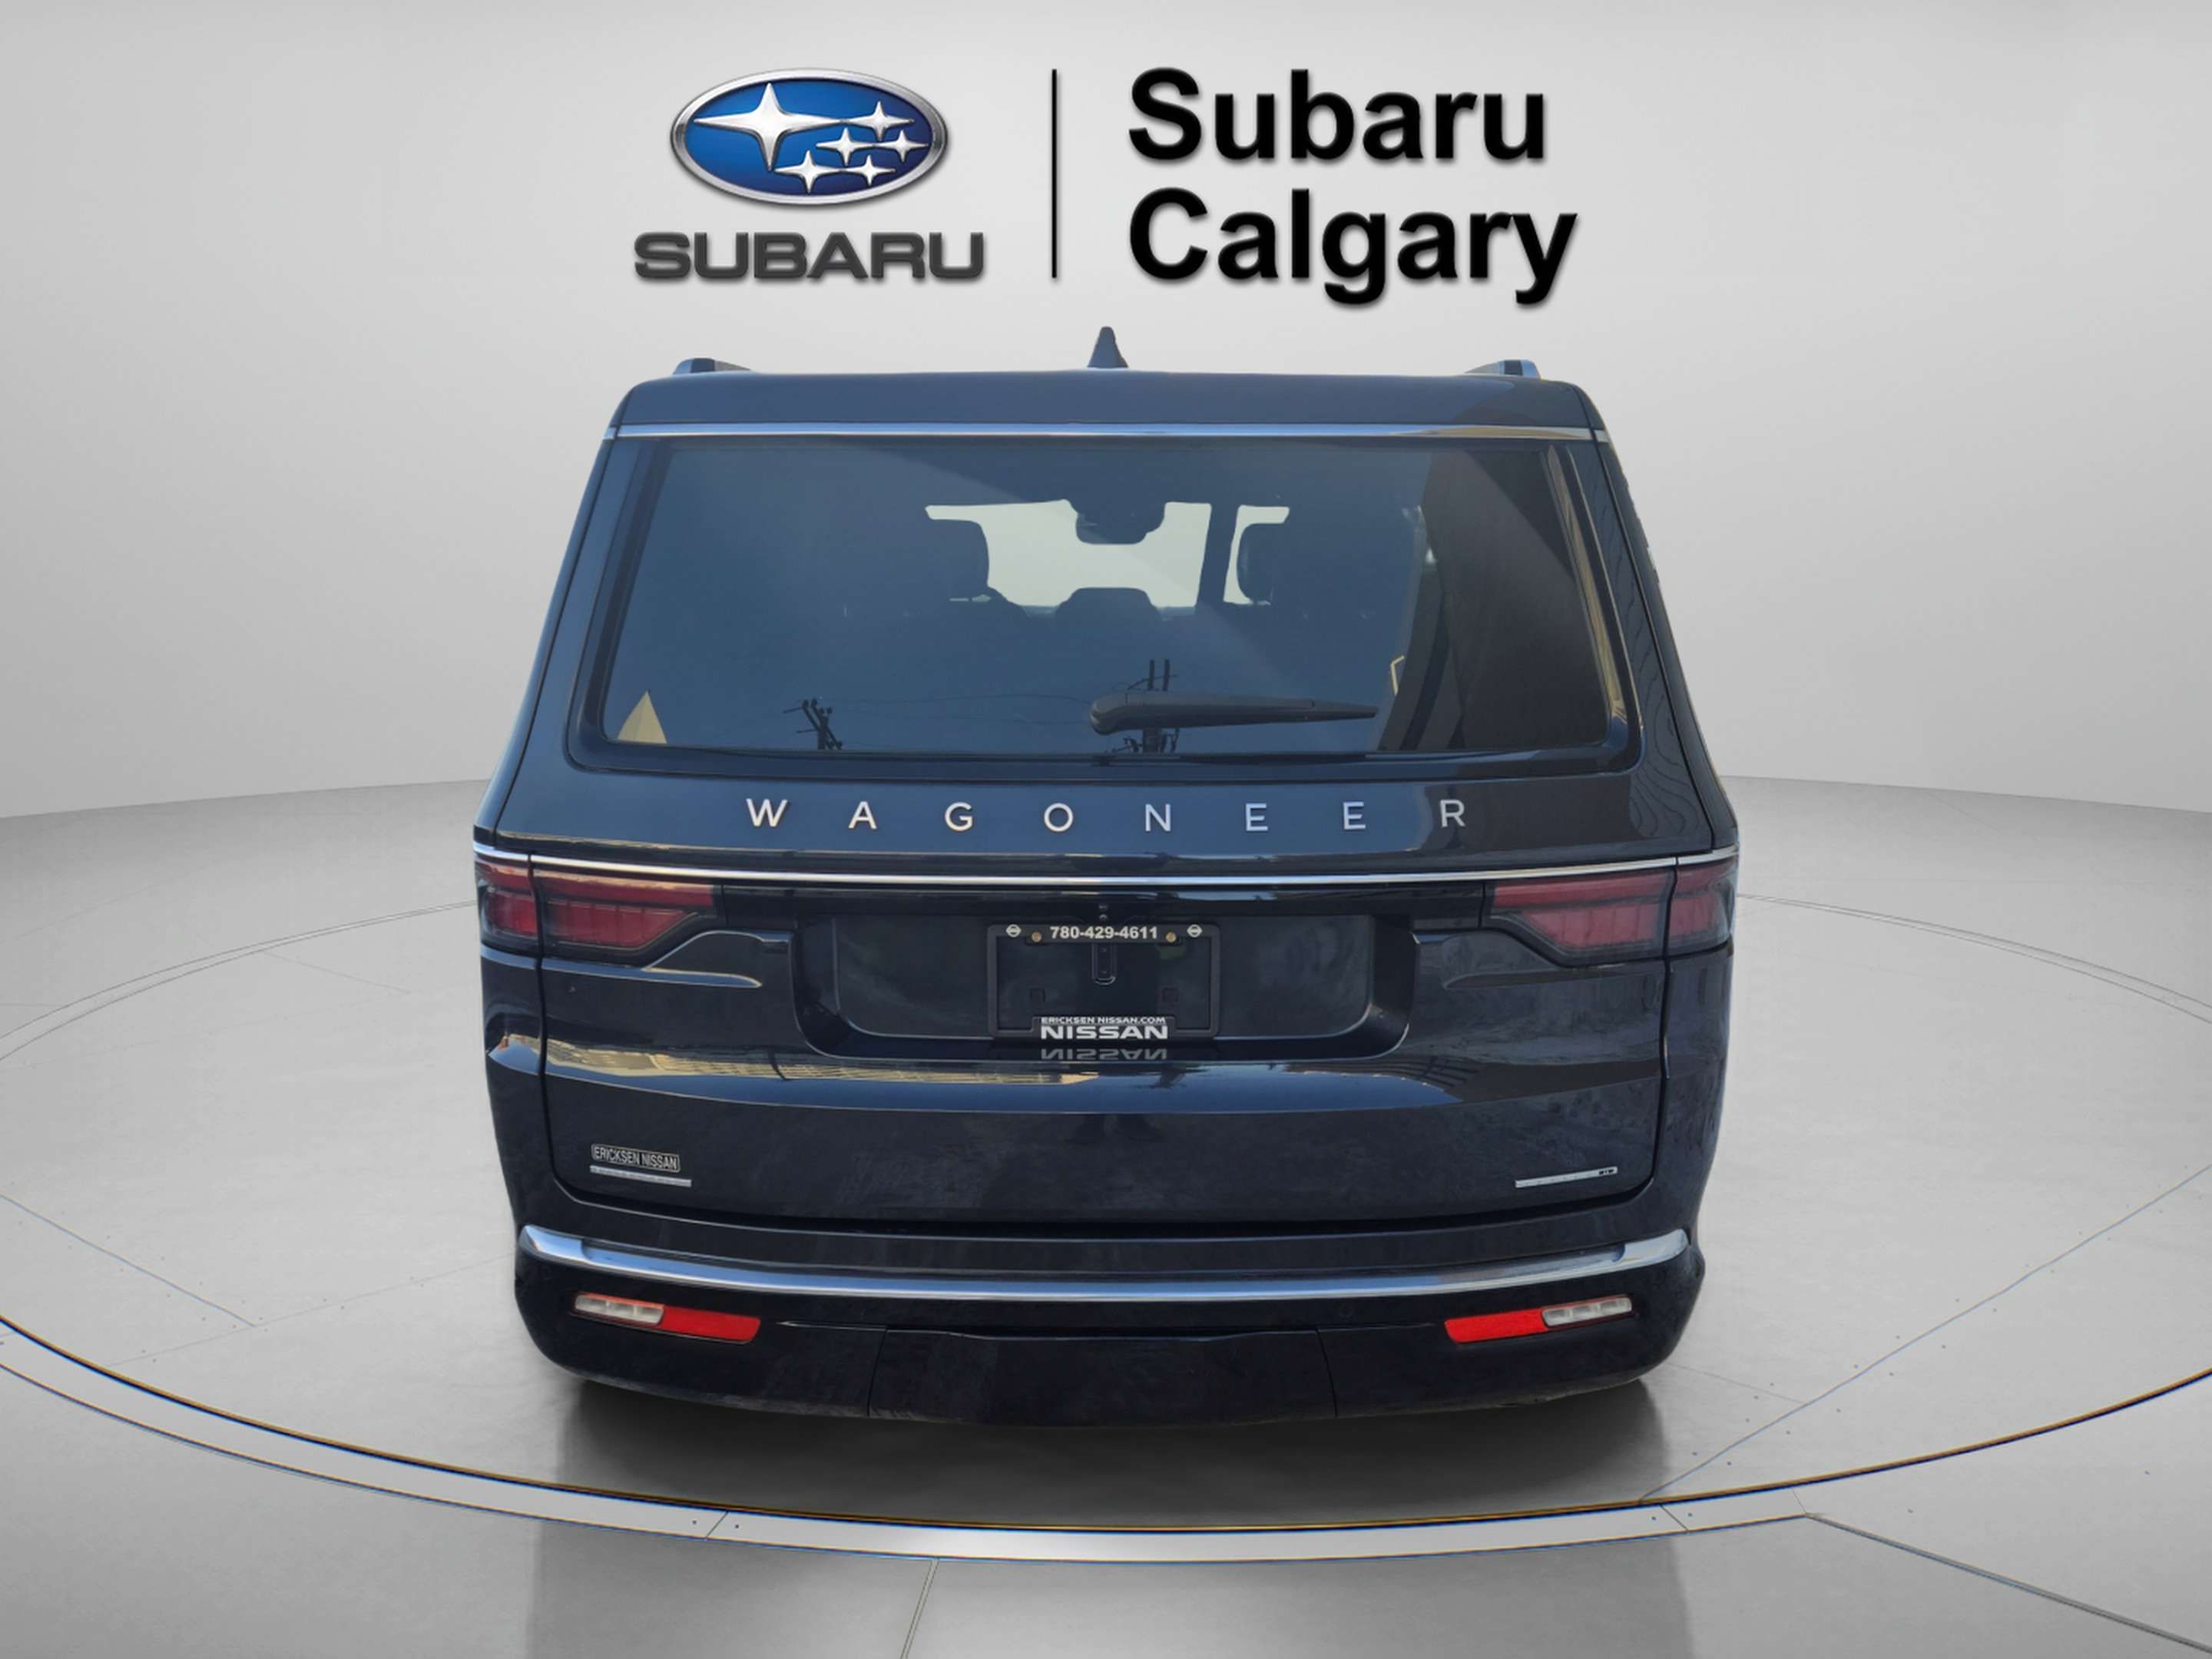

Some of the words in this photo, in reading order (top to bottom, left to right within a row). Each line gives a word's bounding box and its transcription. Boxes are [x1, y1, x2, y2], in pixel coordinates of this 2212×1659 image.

[746, 798, 1466, 832] WAGONEER
[1050, 926, 1157, 939] 780-429-4611
[1040, 1025, 1168, 1039] NISSAN
[594, 1146, 640, 1165] ERICKSEN
[641, 1153, 677, 1170] NISSAN
